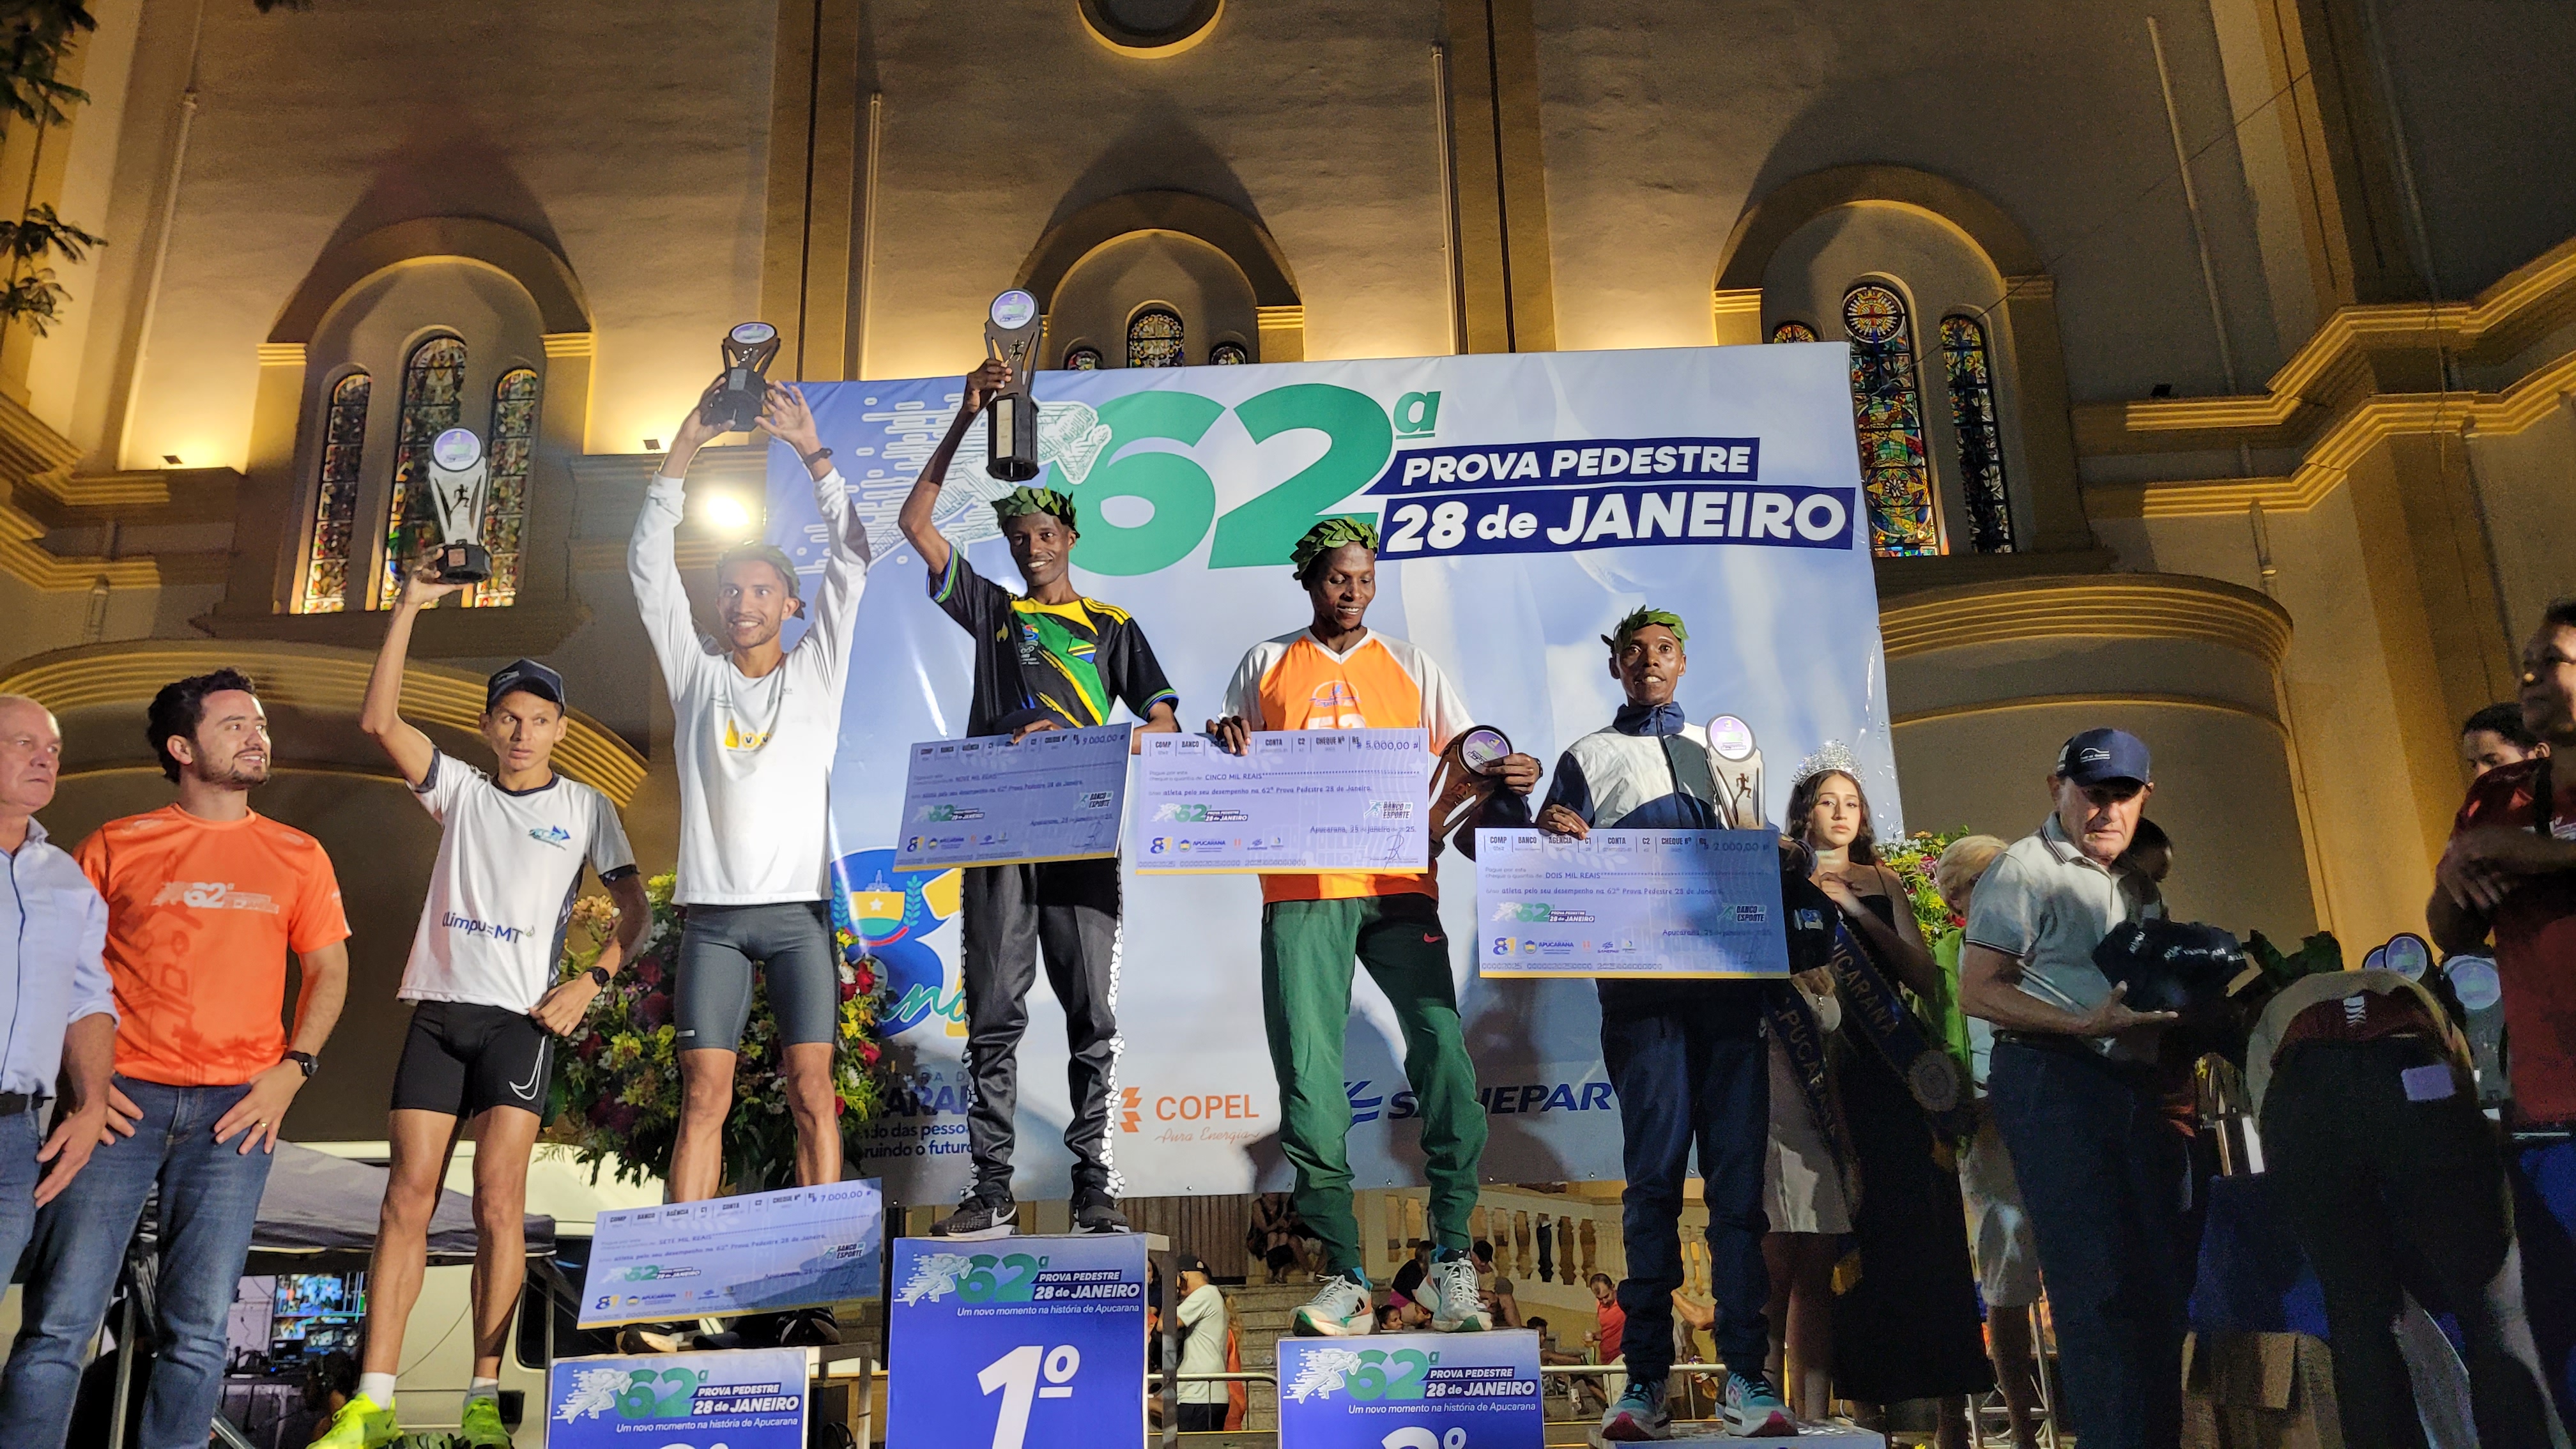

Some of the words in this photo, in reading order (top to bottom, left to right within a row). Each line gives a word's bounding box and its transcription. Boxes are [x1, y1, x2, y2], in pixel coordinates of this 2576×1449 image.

[1402, 452, 1540, 486] PROVA
[1551, 447, 1750, 477] PEDESTRE
[1386, 503, 1469, 552] 28
[1478, 511, 1538, 539] de
[1547, 492, 1845, 546] JANEIRO
[1156, 1094, 1259, 1120] COPEL
[891, 1123, 917, 1136] das
[1155, 1128, 1193, 1144] Pura
[1200, 1126, 1261, 1144] Energia
[916, 1146, 924, 1155] o
[1039, 1272, 1071, 1282] PROVA
[1073, 1271, 1119, 1281] PEDESTRE
[1034, 1286, 1054, 1300] 28
[1055, 1287, 1070, 1298] de
[1071, 1284, 1140, 1299] JANEIRO
[958, 1308, 972, 1317] Um
[996, 1307, 1036, 1315] momento
[1050, 1305, 1081, 1314] história
[1083, 1305, 1093, 1313] de
[1095, 1304, 1138, 1314] Apucarana
[1430, 1369, 1464, 1379] PROVA
[1466, 1368, 1513, 1377] PEDESTRE
[698, 1386, 731, 1397] PROVA
[733, 1383, 779, 1395] PEDESTRE
[1427, 1384, 1446, 1397] 28
[1447, 1384, 1462, 1394] de
[1463, 1381, 1535, 1397] JANEIRO
[693, 1400, 713, 1414] 28
[714, 1400, 729, 1412] de
[730, 1396, 799, 1413] JANEIRO
[1349, 1405, 1364, 1414] Um
[1388, 1404, 1429, 1413] momento
[1444, 1402, 1475, 1413] história
[1476, 1402, 1488, 1411] de
[1489, 1402, 1536, 1413] Apucarana
[617, 1423, 631, 1433] Um
[655, 1422, 696, 1430] momento
[709, 1418, 740, 1429] história
[742, 1418, 752, 1427] de
[754, 1417, 798, 1429] Apucarana
